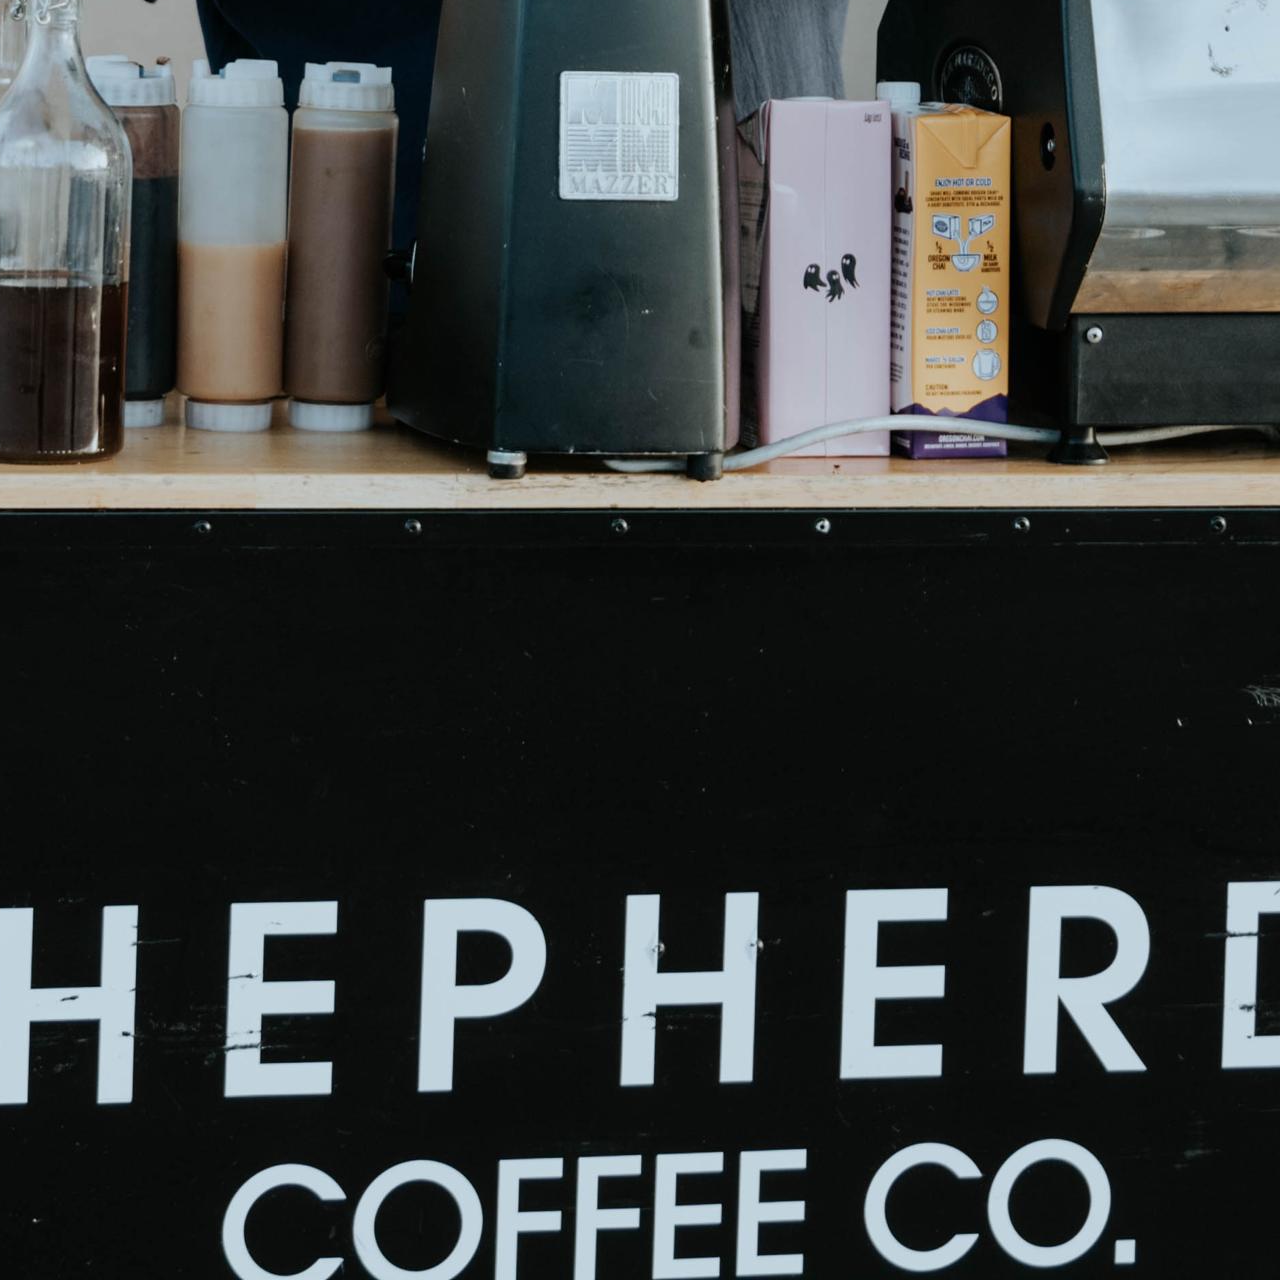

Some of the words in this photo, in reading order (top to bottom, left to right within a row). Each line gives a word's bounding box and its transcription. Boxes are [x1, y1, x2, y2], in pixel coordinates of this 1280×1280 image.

[567, 175, 670, 195] MAZZER
[928, 254, 951, 262] OREGON
[222, 1149, 807, 1280] COFFEE
[864, 1139, 1136, 1272] CO.
